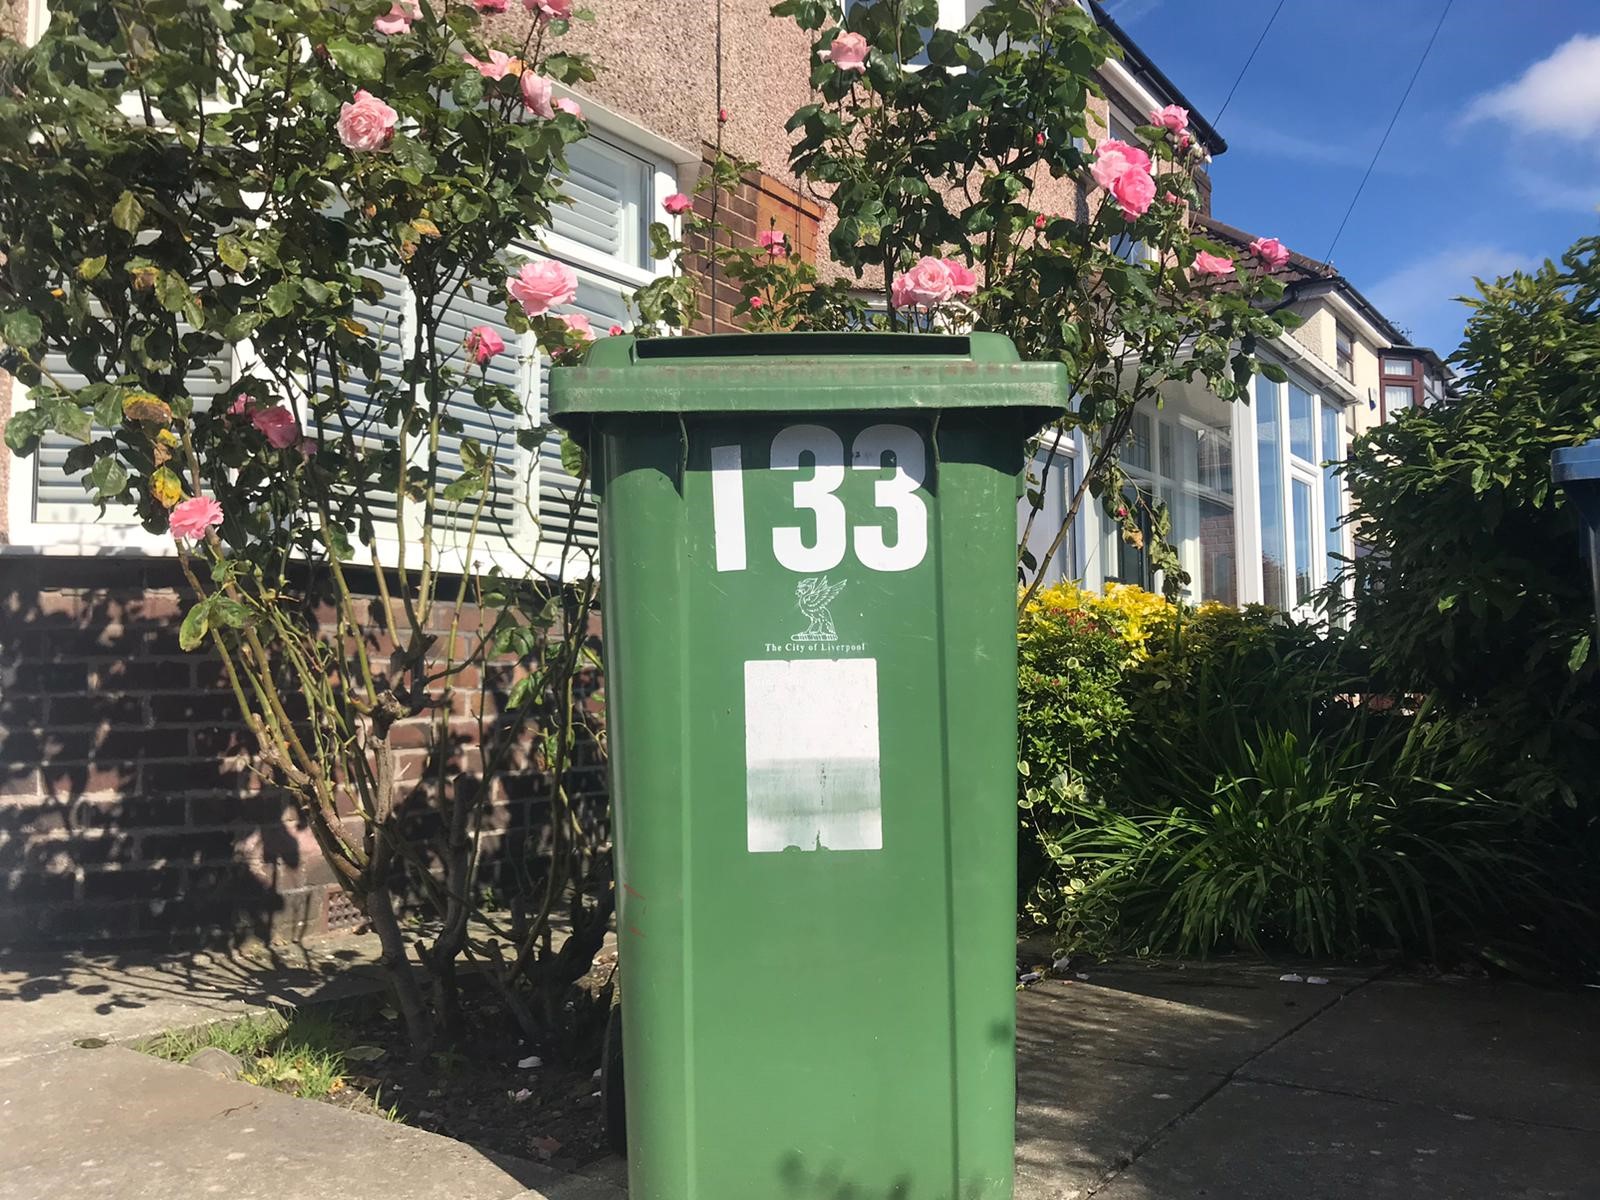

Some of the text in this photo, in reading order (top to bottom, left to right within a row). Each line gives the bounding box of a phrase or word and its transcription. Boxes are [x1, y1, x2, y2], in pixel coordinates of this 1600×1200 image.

[710, 424, 929, 573] 133
[764, 642, 866, 653] The City of Liverpool
